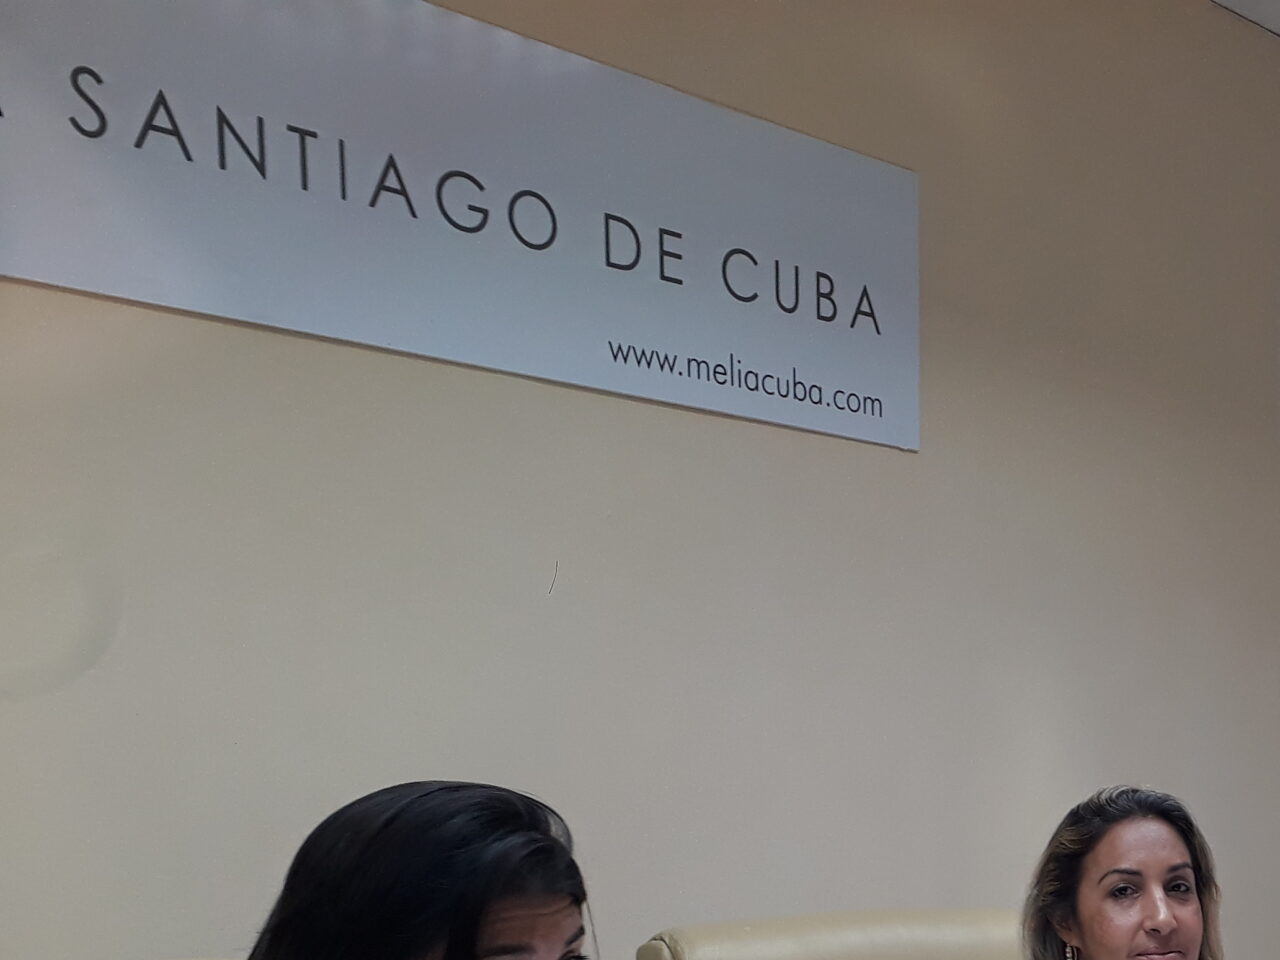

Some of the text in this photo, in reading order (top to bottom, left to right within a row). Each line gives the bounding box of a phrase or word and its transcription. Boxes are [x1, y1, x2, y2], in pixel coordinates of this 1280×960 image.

[68, 65, 882, 336] SANTIAGO DE CUBA
[607, 340, 884, 418] www.meliacuba.com
